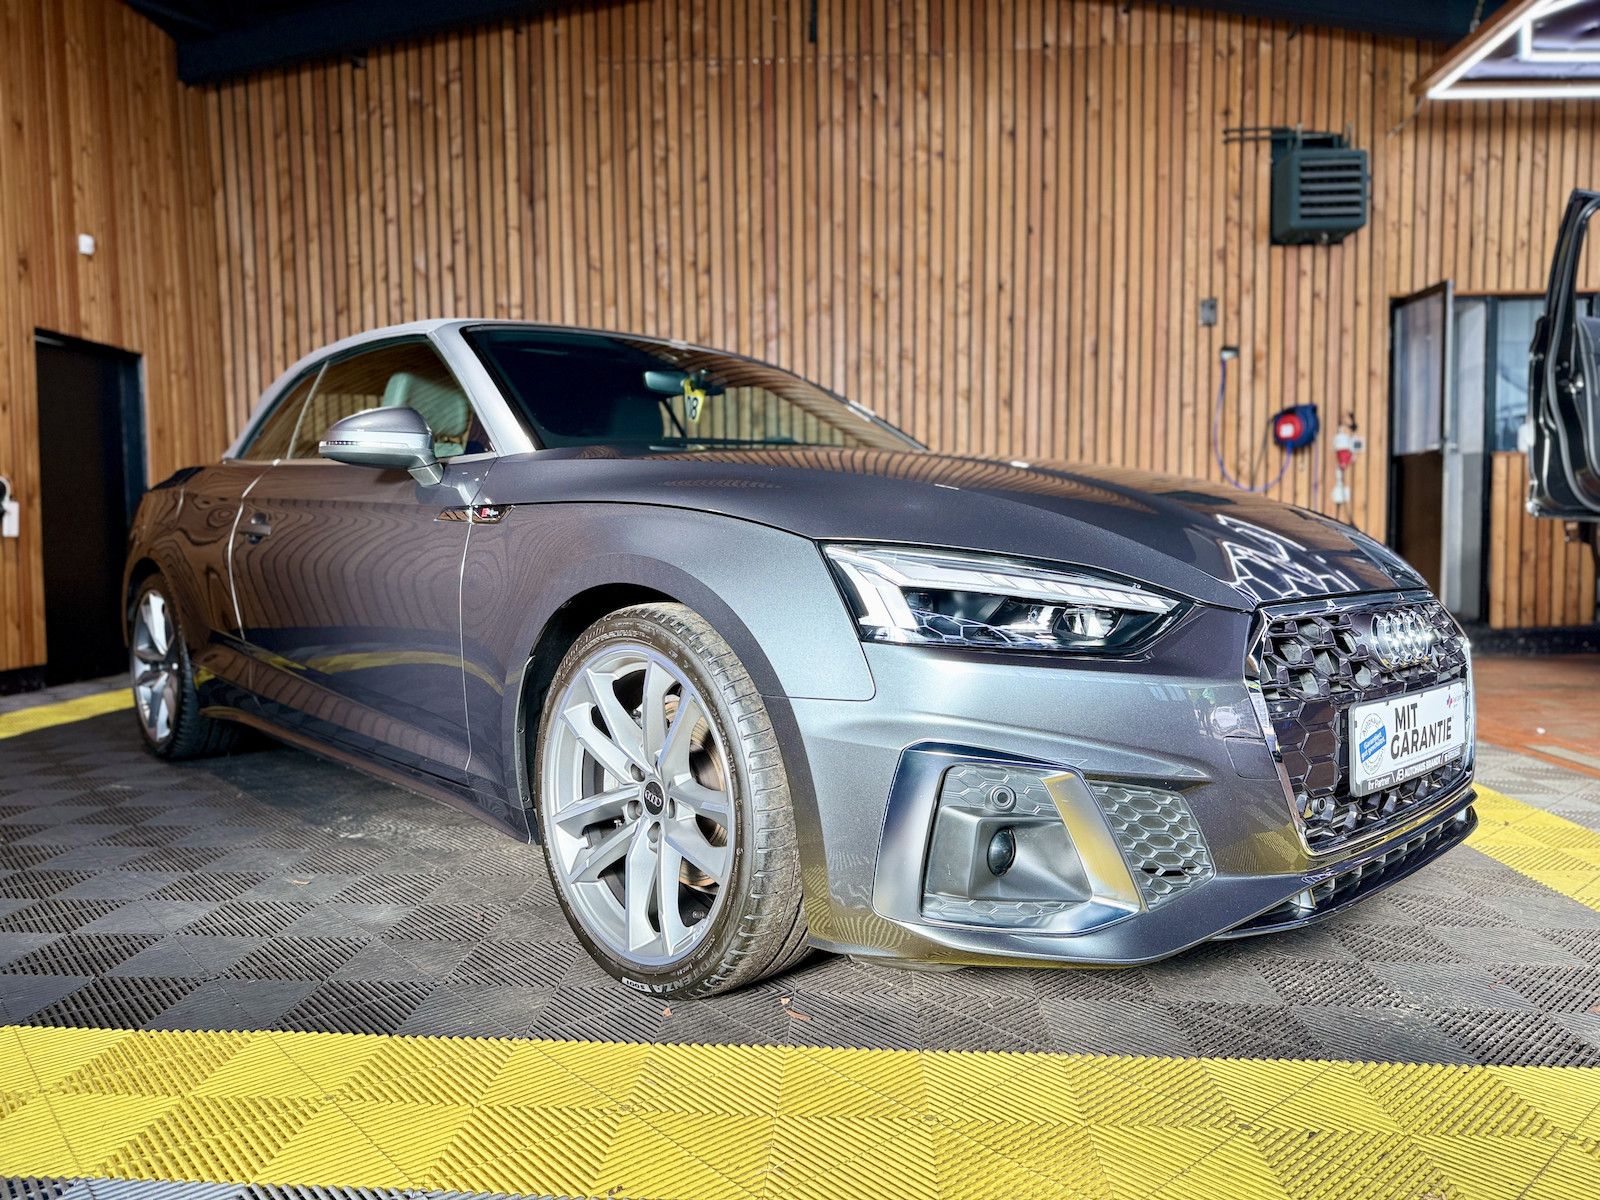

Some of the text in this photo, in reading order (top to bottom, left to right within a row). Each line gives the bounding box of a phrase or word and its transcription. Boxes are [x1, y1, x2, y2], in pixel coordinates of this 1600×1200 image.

[1394, 702, 1418, 732] MIT
[1390, 717, 1452, 760] GARANTIE
[1374, 777, 1391, 789] Partner
